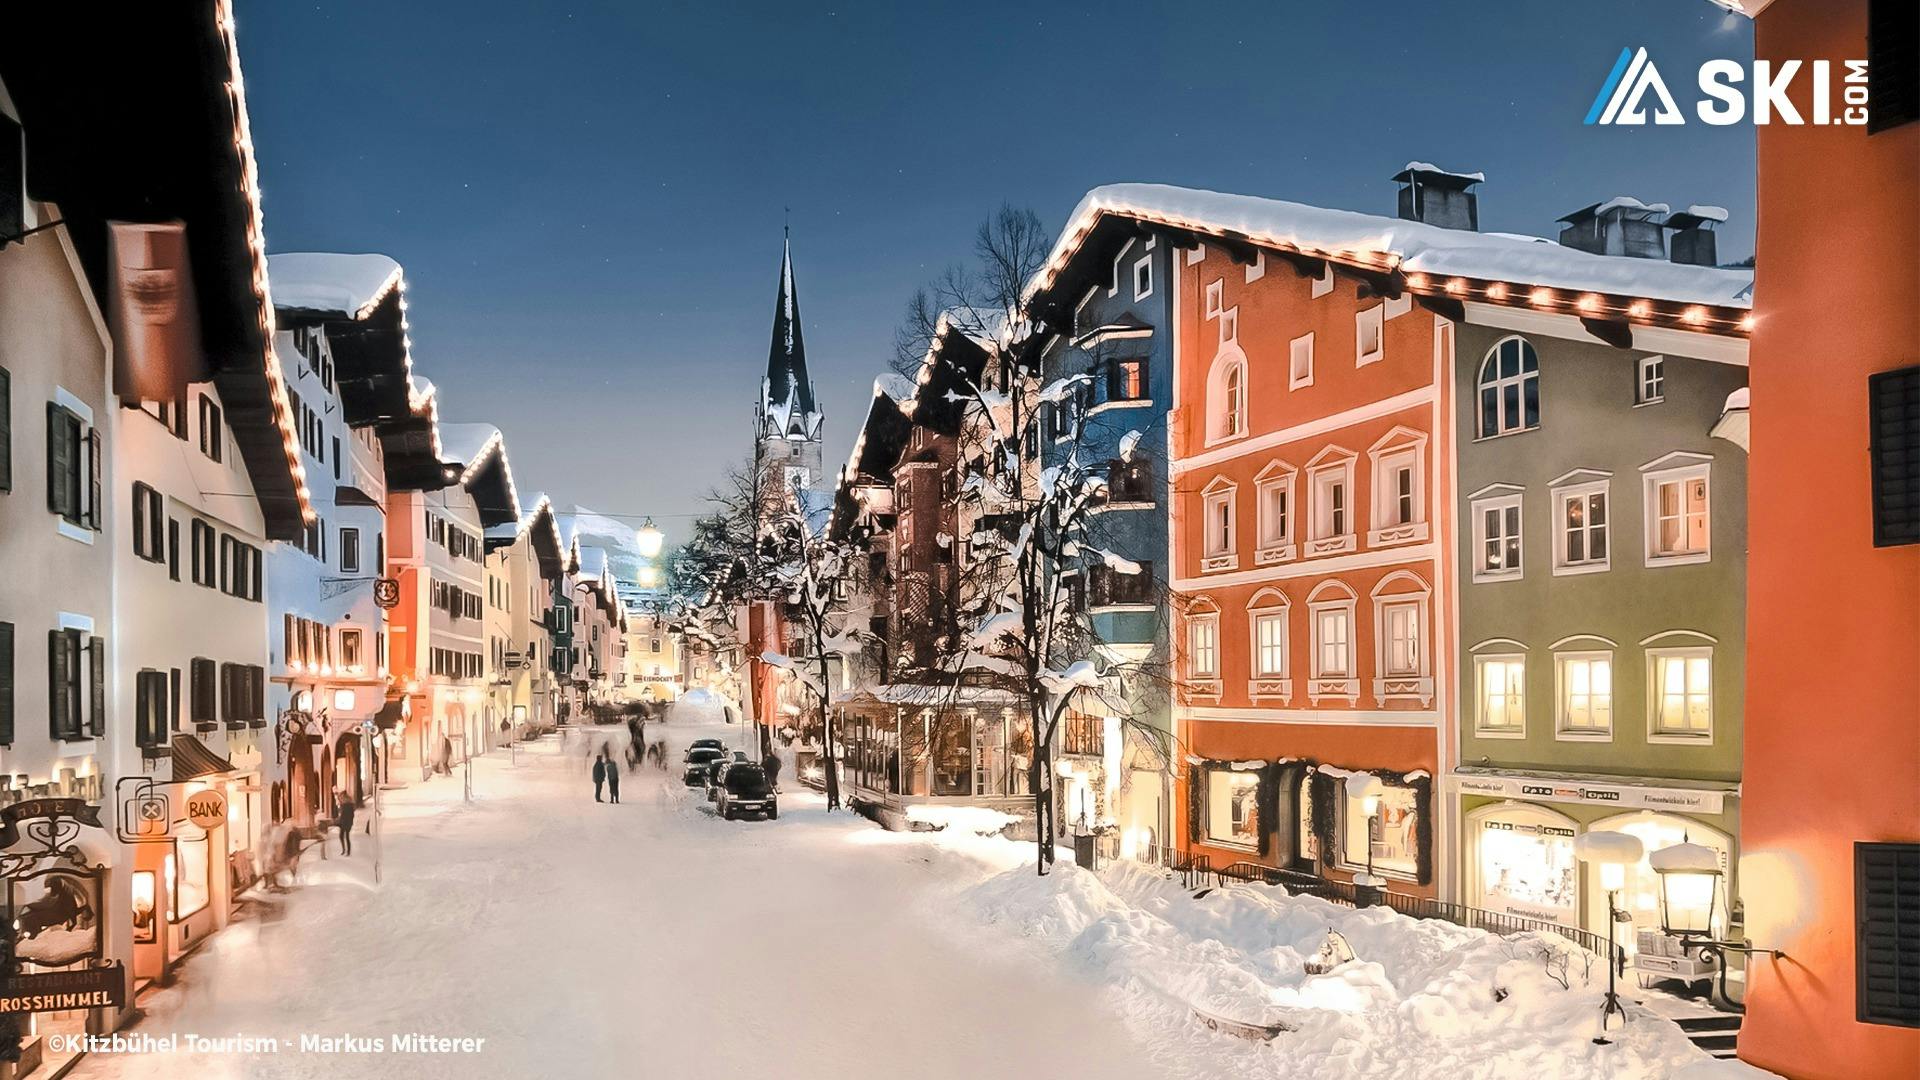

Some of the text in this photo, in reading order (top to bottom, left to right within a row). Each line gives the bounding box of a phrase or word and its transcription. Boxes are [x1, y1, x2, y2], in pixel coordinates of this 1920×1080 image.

[1586, 790, 1619, 800] Optik
[189, 800, 223, 818] BANK
[0, 991, 113, 1013] ROSSHIMMEL
